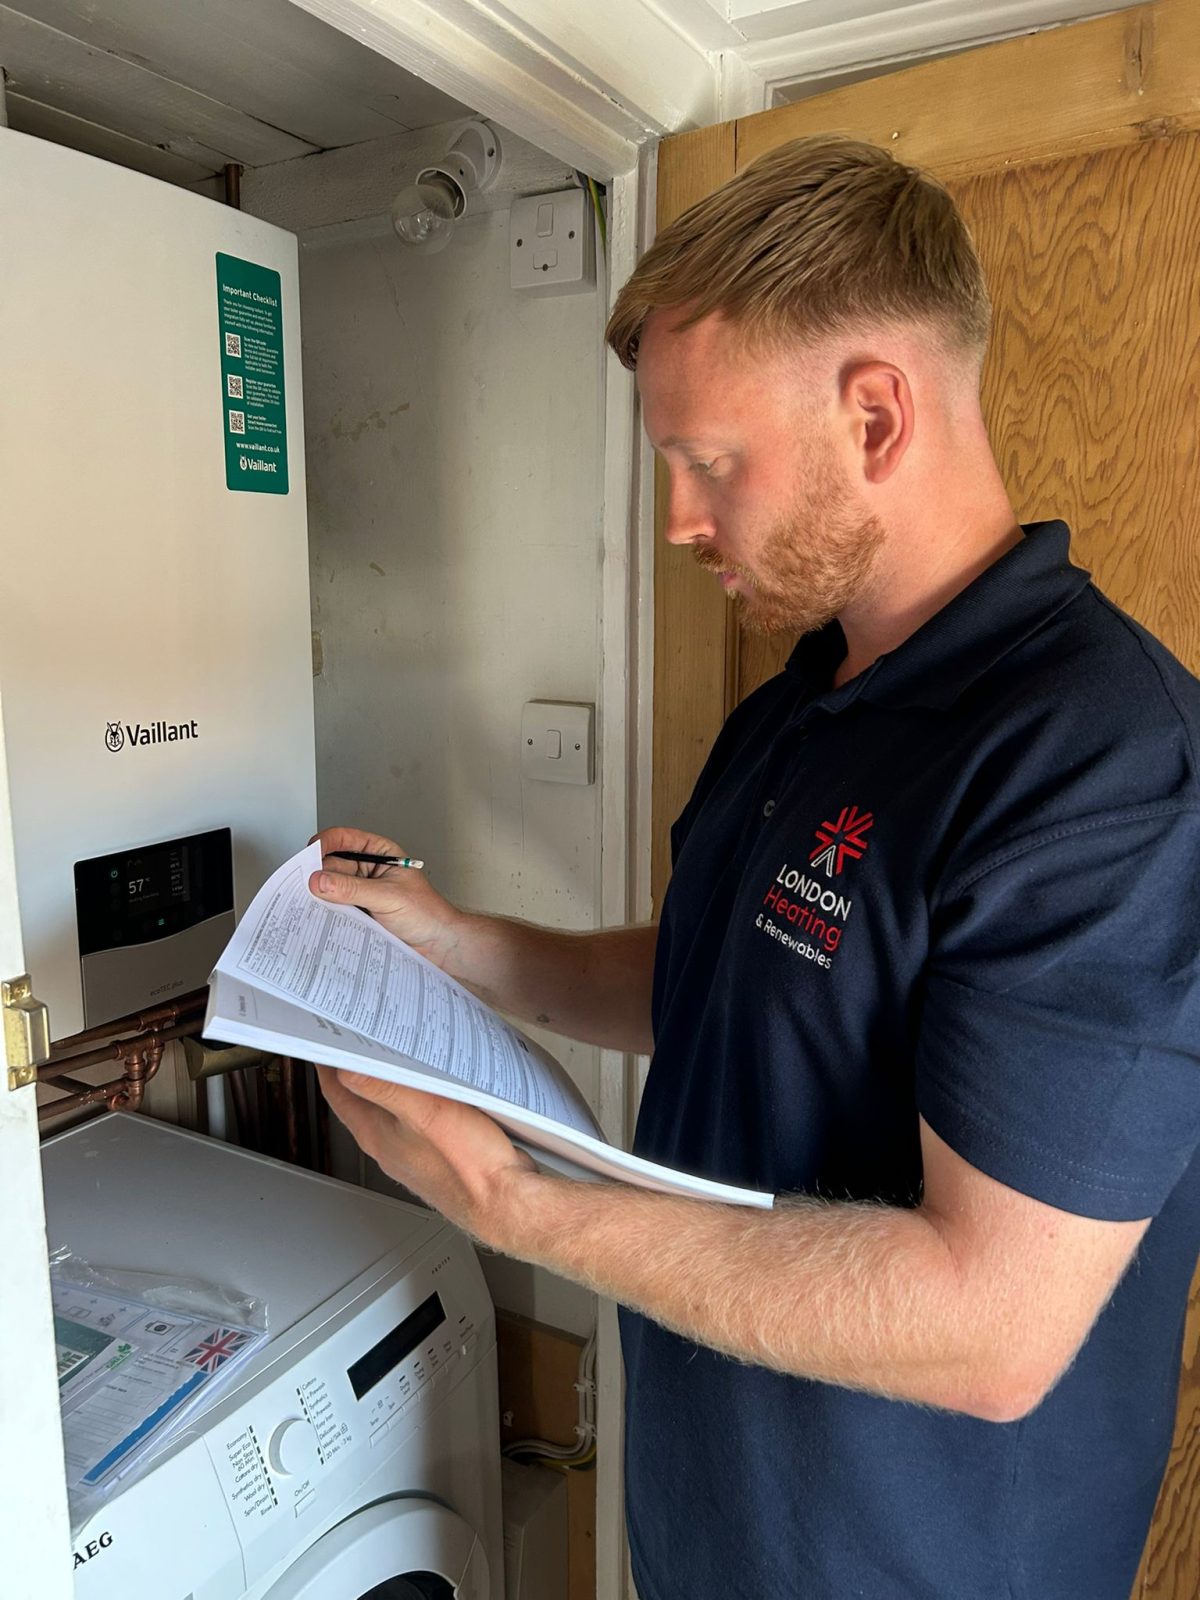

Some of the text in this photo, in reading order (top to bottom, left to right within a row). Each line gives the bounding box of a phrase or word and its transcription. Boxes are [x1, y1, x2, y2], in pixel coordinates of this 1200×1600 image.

[222, 283, 277, 307] Important Checklist
[236, 442, 280, 453] www.vaillant.co.uk
[247, 458, 277, 473] Vaillant
[126, 720, 198, 746] Vaillant
[129, 879, 144, 894] 57
[777, 864, 852, 921] LONDON
[764, 884, 842, 951] Heating
[755, 913, 832, 969] & Renewables
[226, 1432, 247, 1450] Economy
[229, 1442, 251, 1461] Super Eco
[235, 1469, 251, 1483] Cottons
[232, 1480, 254, 1500] Synthetics
[244, 1483, 265, 1501] Wool dry
[294, 1480, 310, 1496] On/Off
[72, 1531, 113, 1571] AEG
